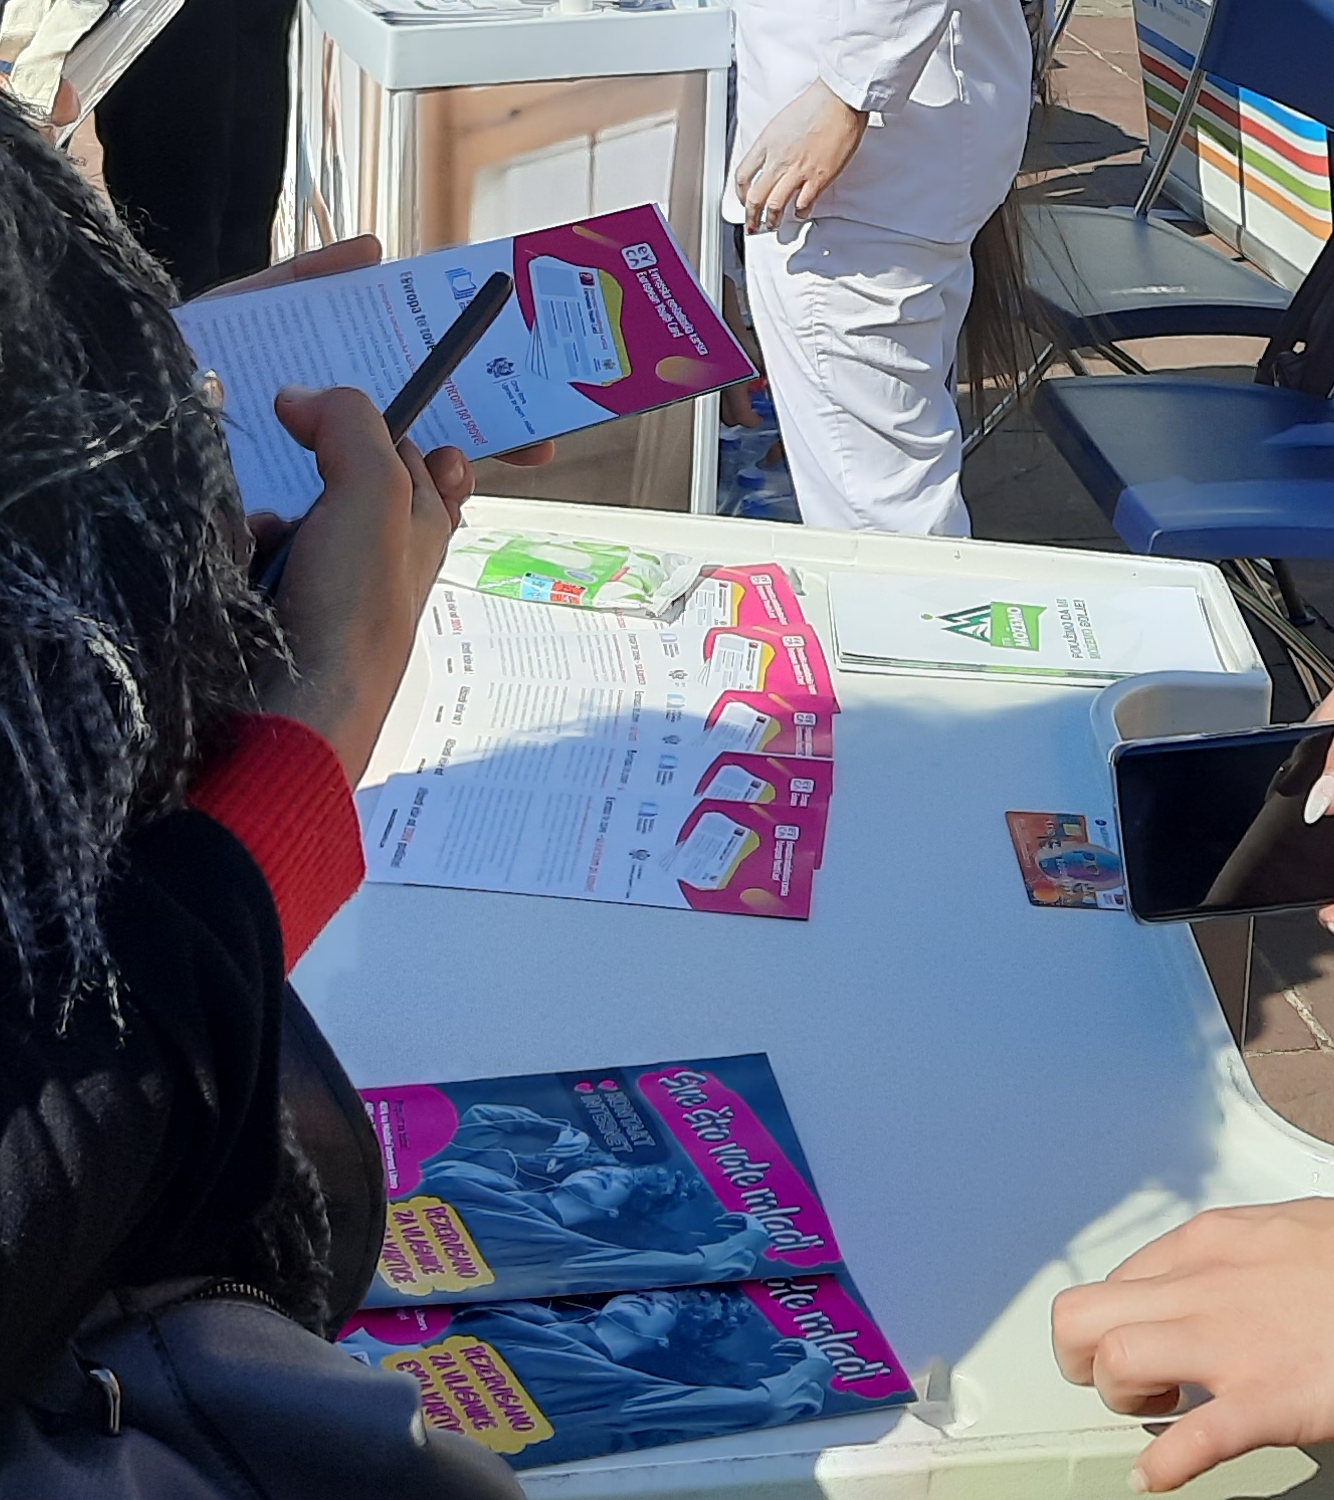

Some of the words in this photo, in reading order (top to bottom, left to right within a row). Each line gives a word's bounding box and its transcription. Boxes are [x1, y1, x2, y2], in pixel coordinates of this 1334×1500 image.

[1006, 606, 1030, 647] MOŽEMO
[659, 1071, 708, 1108] Sve
[580, 1093, 634, 1153] INTERNET
[604, 1091, 656, 1148] KONTAKT
[683, 1106, 733, 1142] što
[393, 1209, 417, 1233] ZA
[423, 1206, 479, 1279] REZERVISANO
[741, 1187, 825, 1253] mladi
[401, 1230, 445, 1276] VLASNIKE
[428, 1352, 456, 1371] ZA
[793, 1311, 892, 1384] mladi
[441, 1369, 499, 1430] VLASNIKE
[460, 1345, 535, 1432] REZERVISANO
